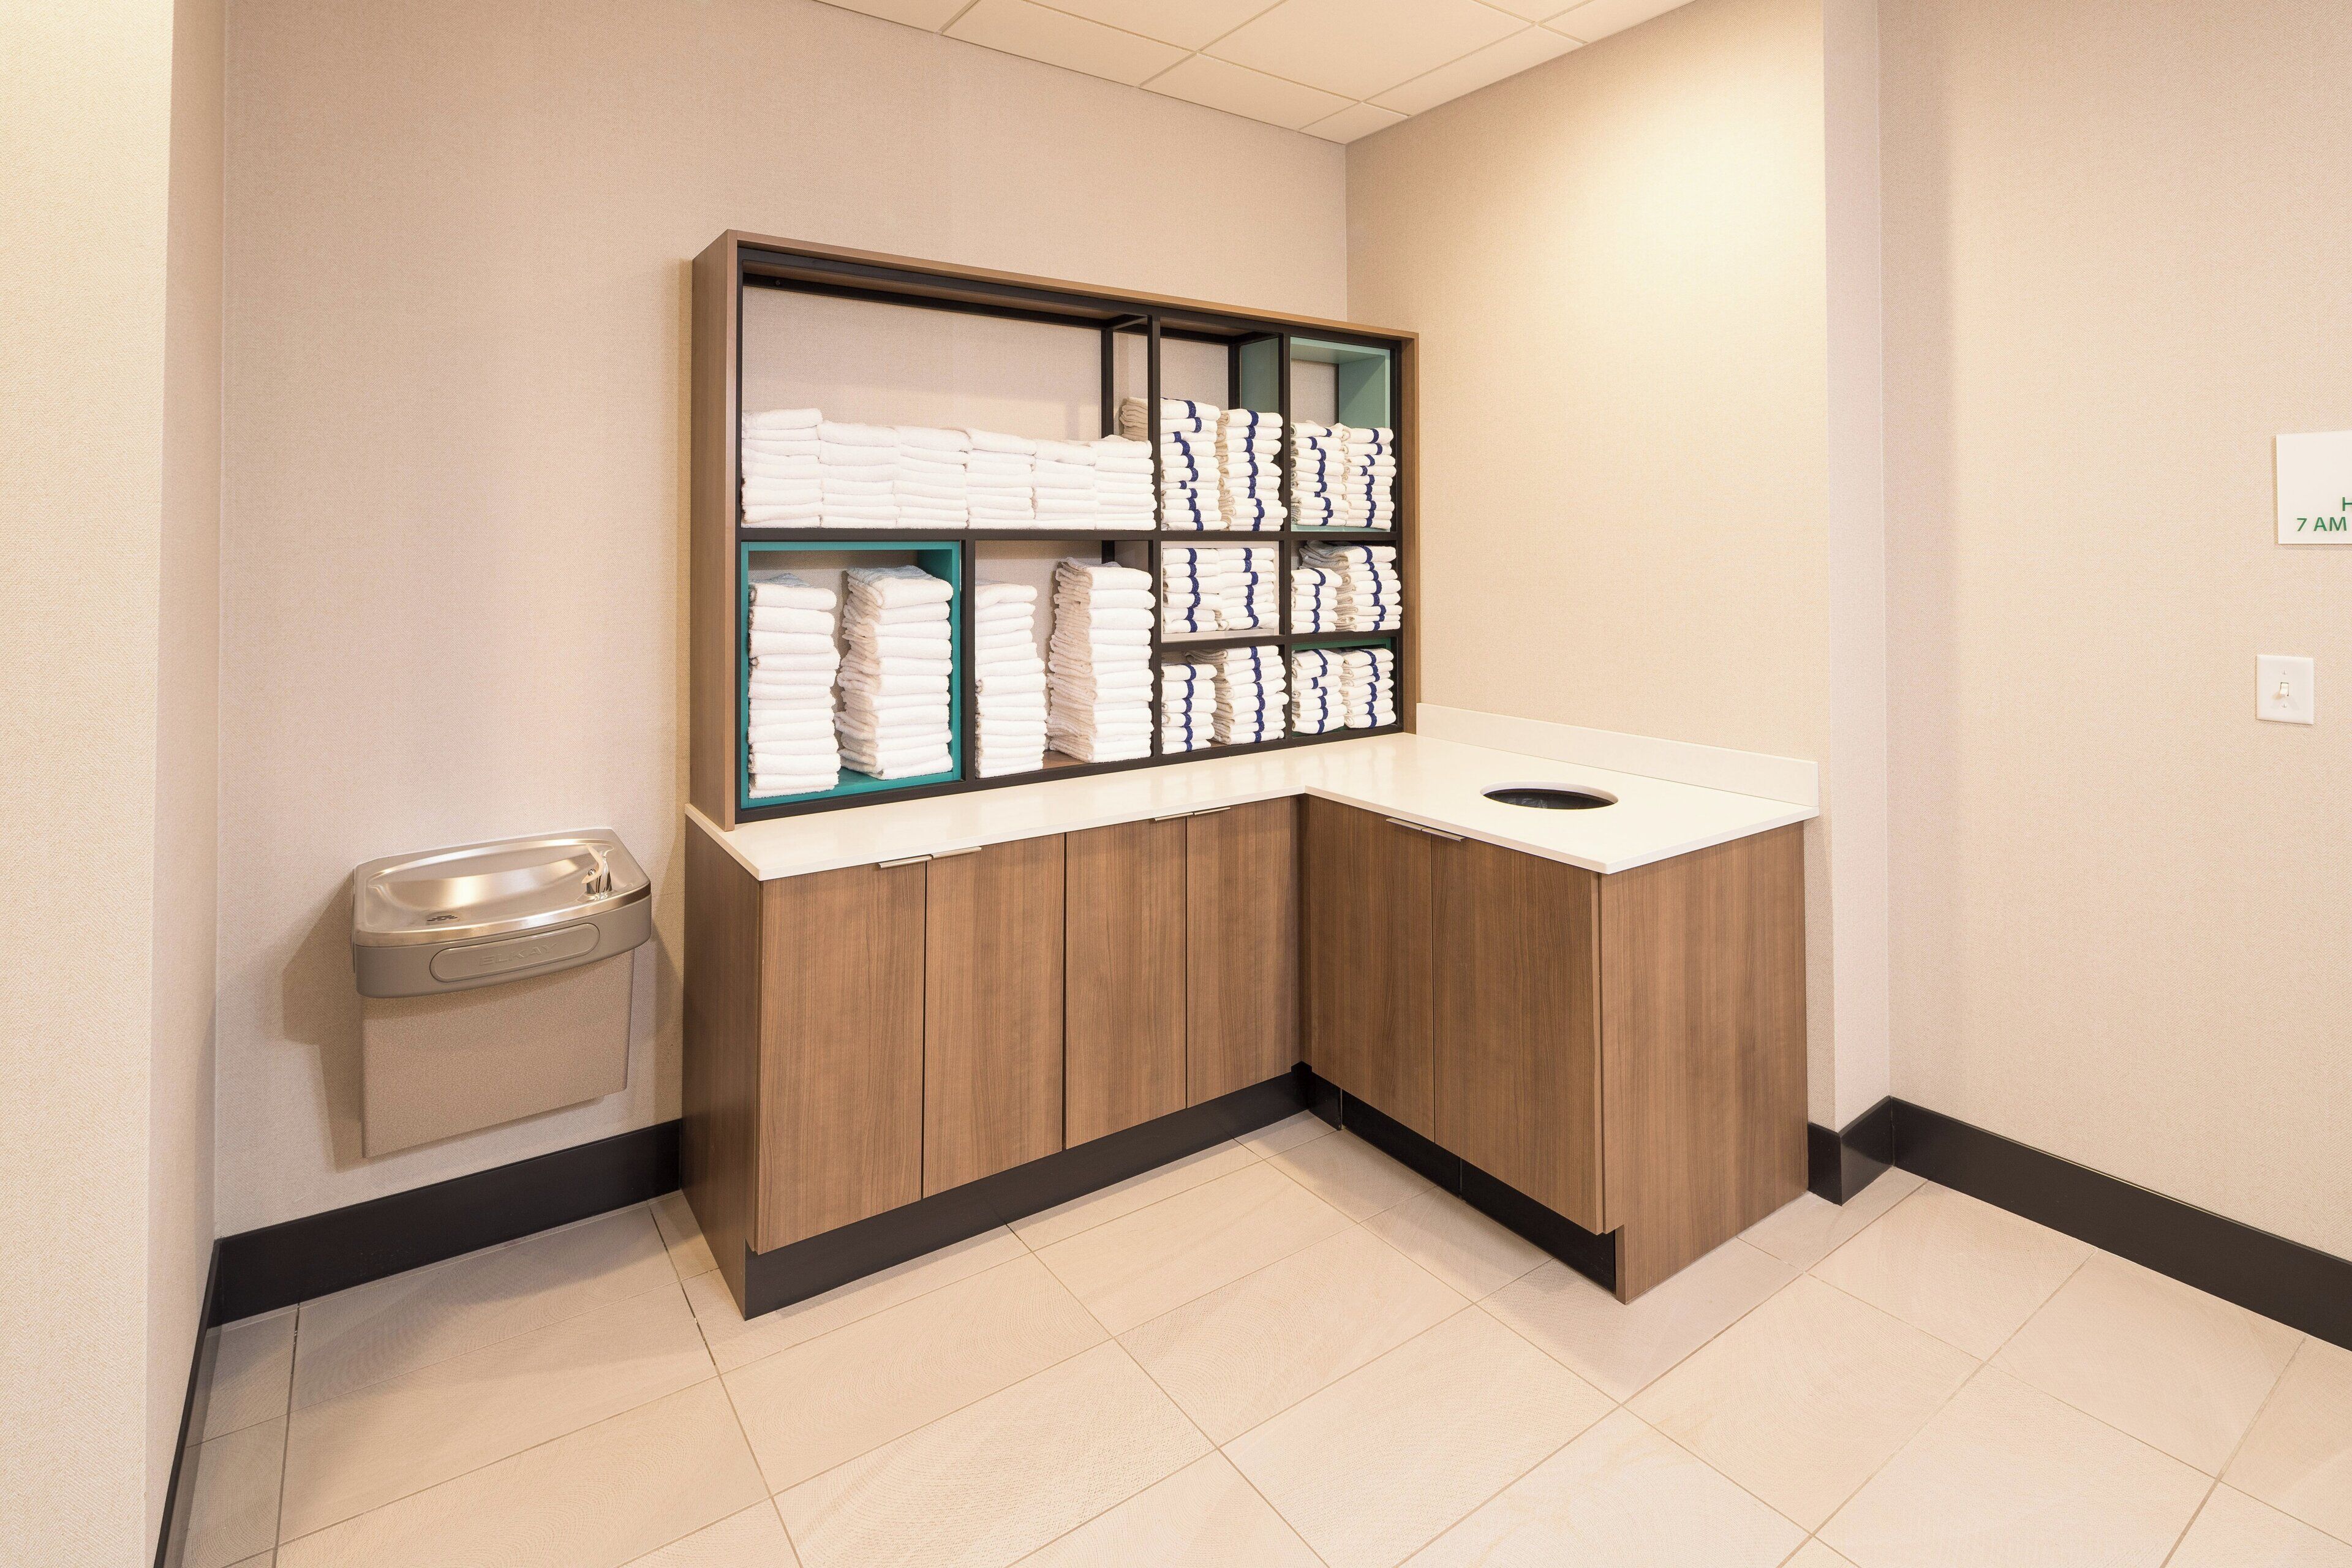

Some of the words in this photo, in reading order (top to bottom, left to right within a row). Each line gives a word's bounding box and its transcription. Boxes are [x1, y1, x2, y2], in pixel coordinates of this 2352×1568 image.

[2297, 518, 2307, 532] 7
[2313, 516, 2347, 532] AM
[480, 943, 557, 966] ELKAY
